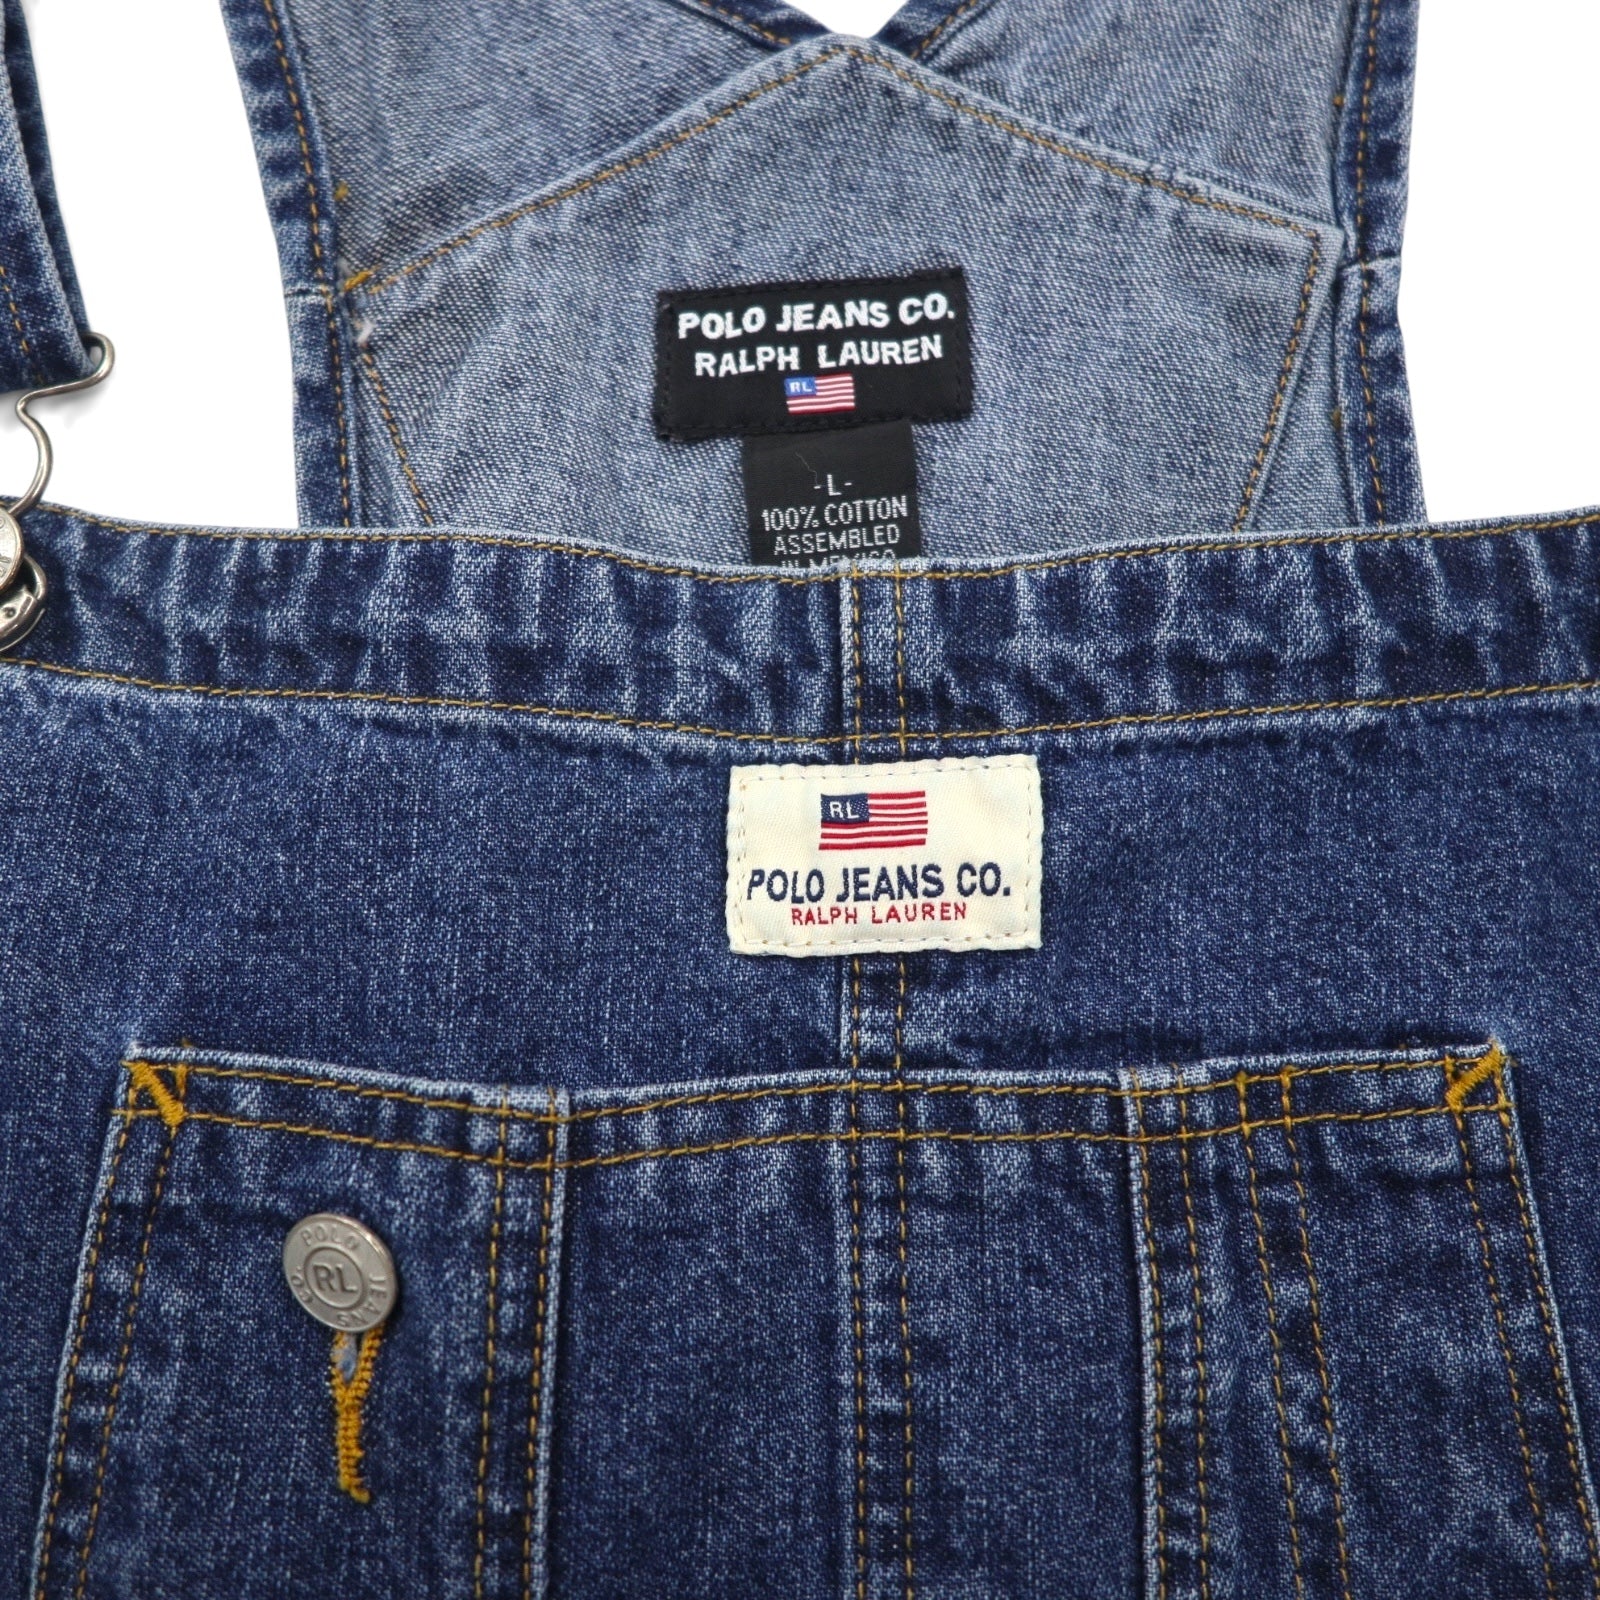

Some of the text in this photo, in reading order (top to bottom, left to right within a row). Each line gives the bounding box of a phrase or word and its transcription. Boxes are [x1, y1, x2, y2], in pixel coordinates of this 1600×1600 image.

[677, 292, 955, 340] POLO JEANS CO.
[694, 334, 944, 378] RALPH LAUREN
[789, 380, 813, 394] RL
[760, 495, 908, 533] 100% COTTON
[773, 523, 900, 556] ASSEMBLED
[830, 801, 859, 820] RL
[747, 861, 1012, 904] POLO JEANS CO.
[791, 901, 967, 926] RALPH LAUREN
[300, 1223, 359, 1251] POLO
[337, 1273, 387, 1327] JEANS
[313, 1262, 358, 1293] RL
